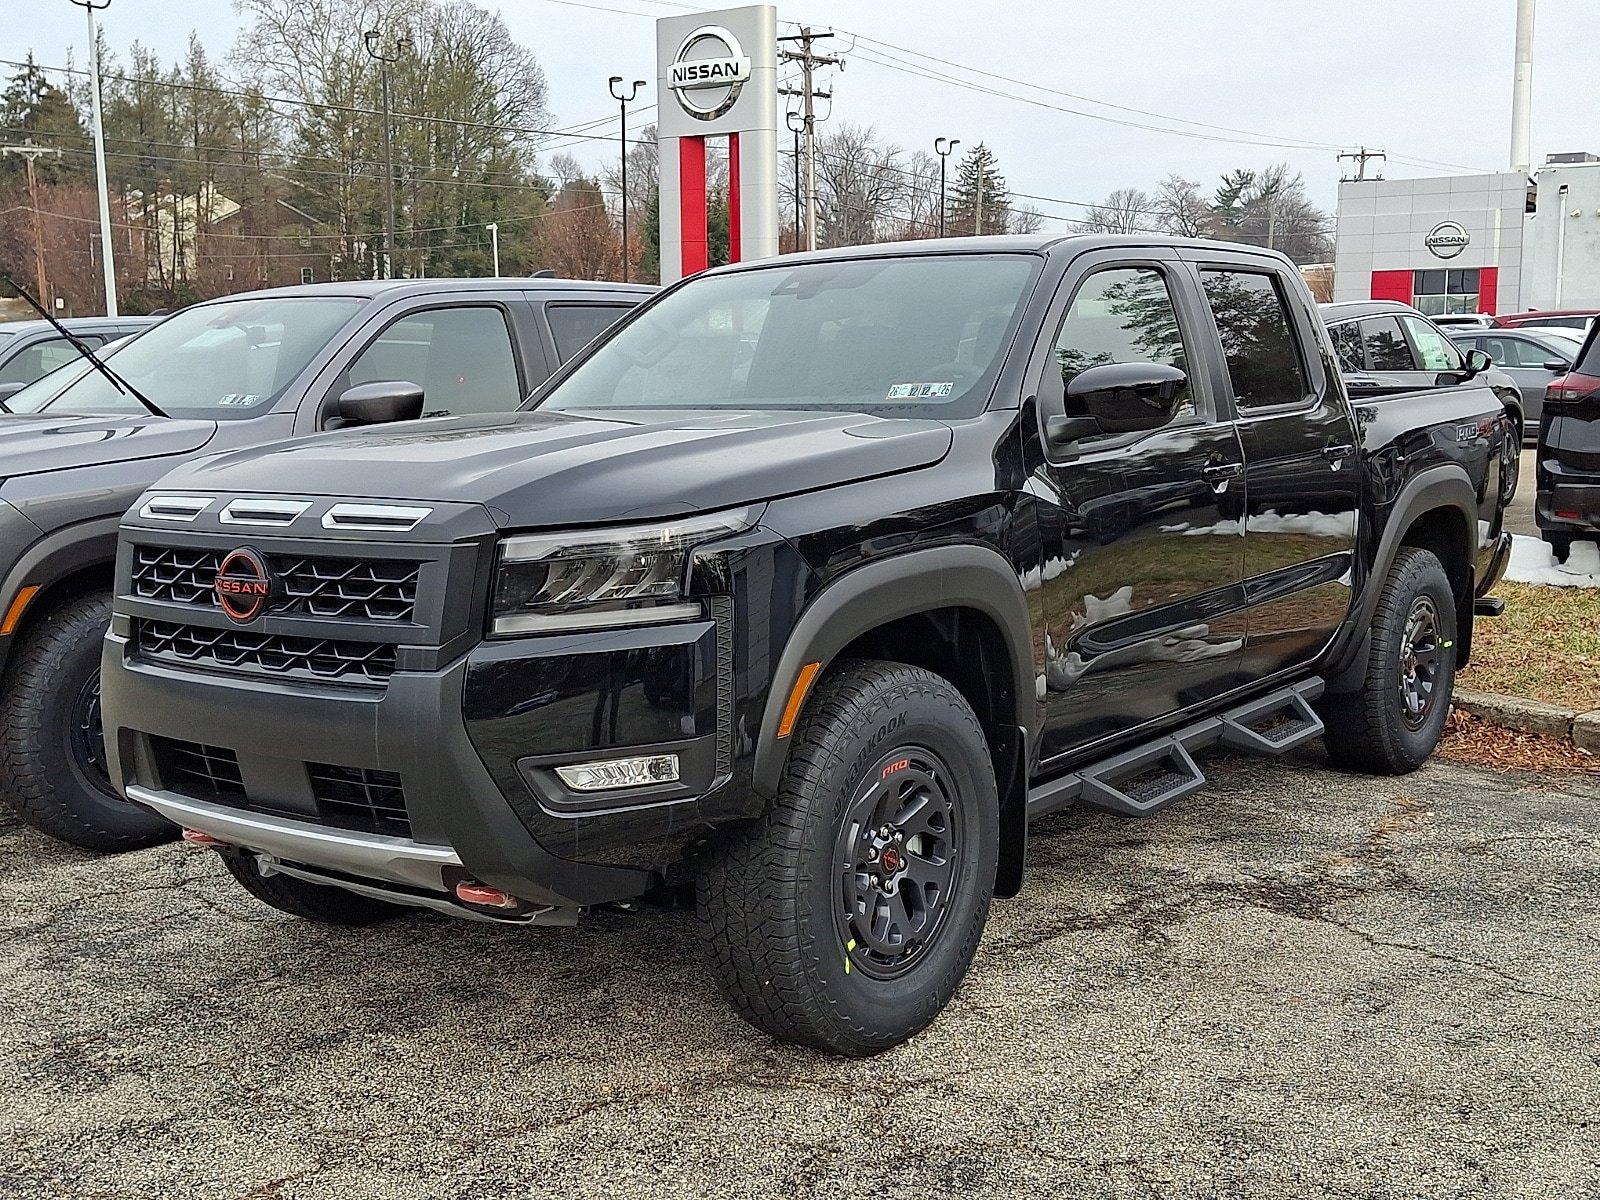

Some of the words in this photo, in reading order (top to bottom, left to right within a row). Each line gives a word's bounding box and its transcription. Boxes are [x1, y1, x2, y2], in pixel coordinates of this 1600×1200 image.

[672, 61, 739, 82] NISSAN
[1429, 236, 1465, 244] NISSAN
[215, 578, 267, 594] NISSAN
[882, 759, 909, 779] PRO
